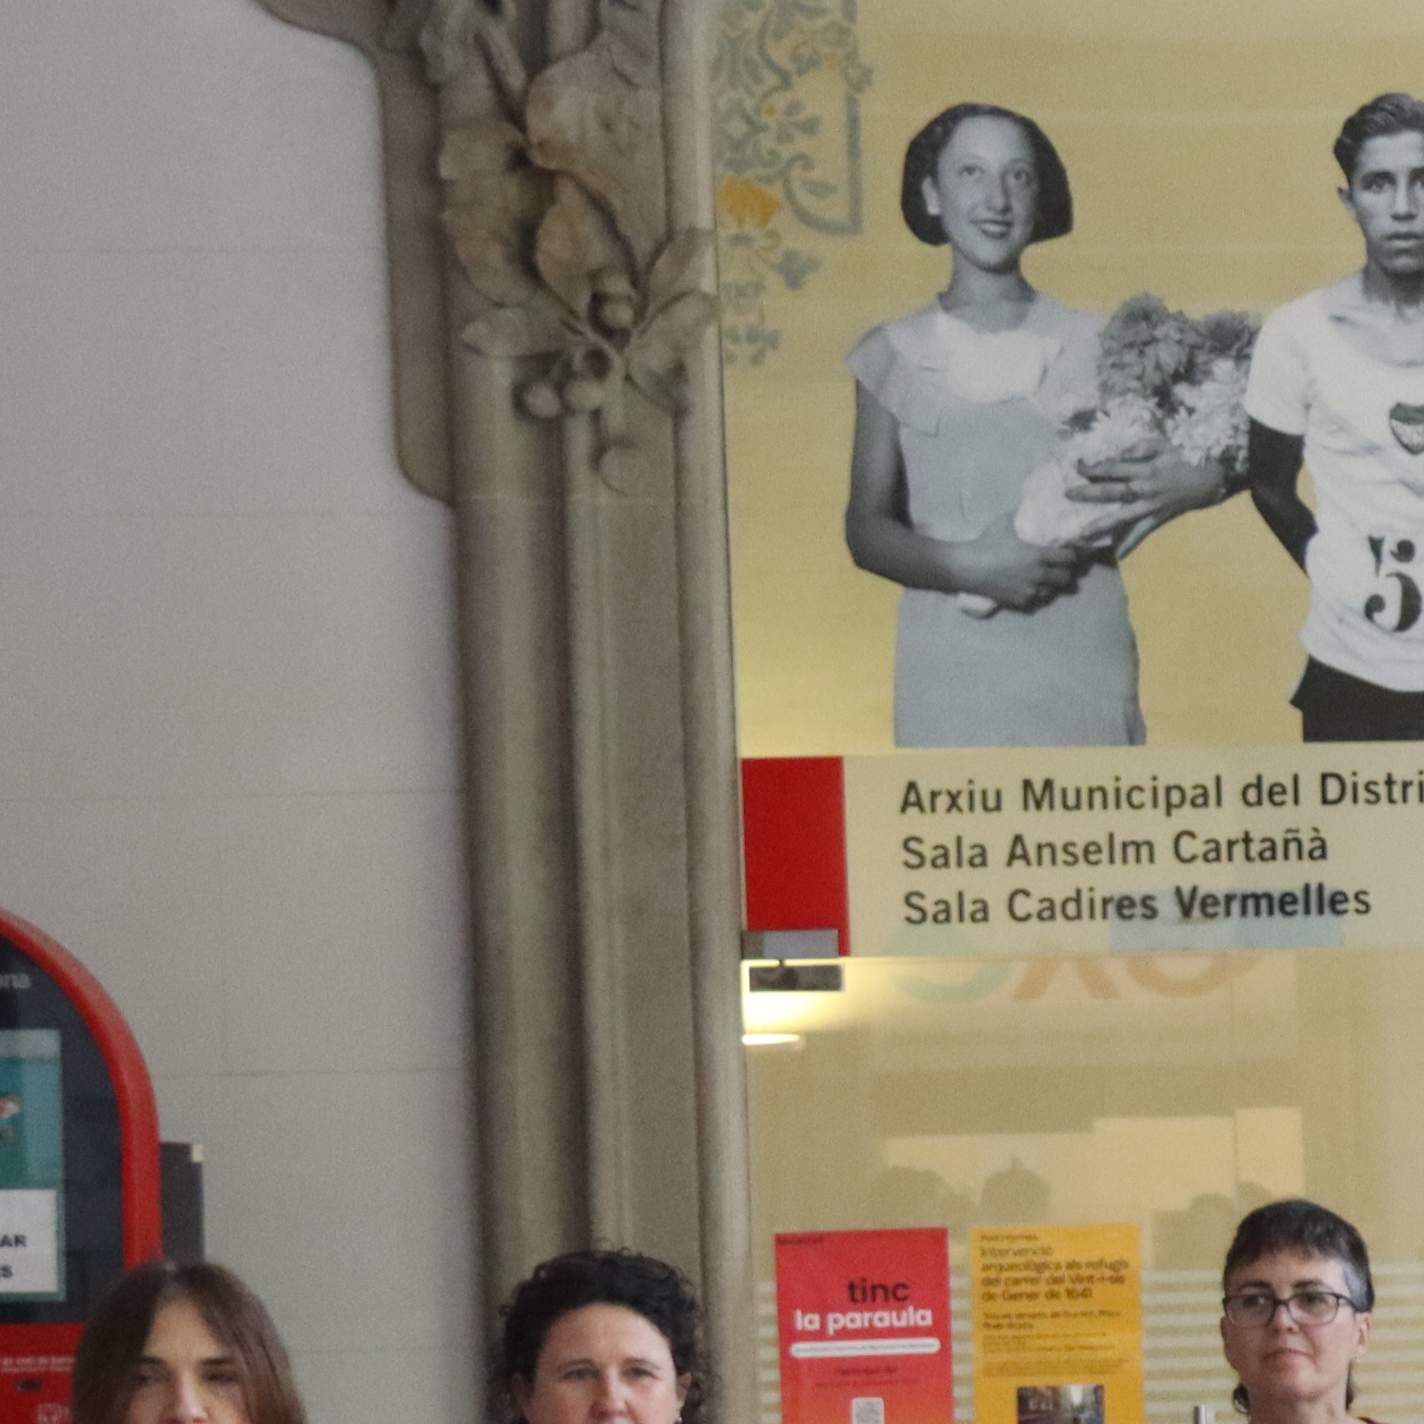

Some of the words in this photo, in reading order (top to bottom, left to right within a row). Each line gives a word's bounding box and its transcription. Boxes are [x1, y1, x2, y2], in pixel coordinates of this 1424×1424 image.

[900, 779, 1002, 814] Arxiu
[1022, 775, 1222, 817] Municipal
[1242, 773, 1299, 807] del
[902, 835, 988, 869] Sala
[1006, 832, 1155, 867] Anselm
[1173, 827, 1328, 863] Cartañà
[904, 890, 990, 925] Sala
[1008, 887, 1159, 922] Cadires
[1174, 882, 1372, 919] Vermelles
[848, 1278, 910, 1303] tinc
[795, 1309, 821, 1331] la
[826, 1306, 933, 1336] paraula
